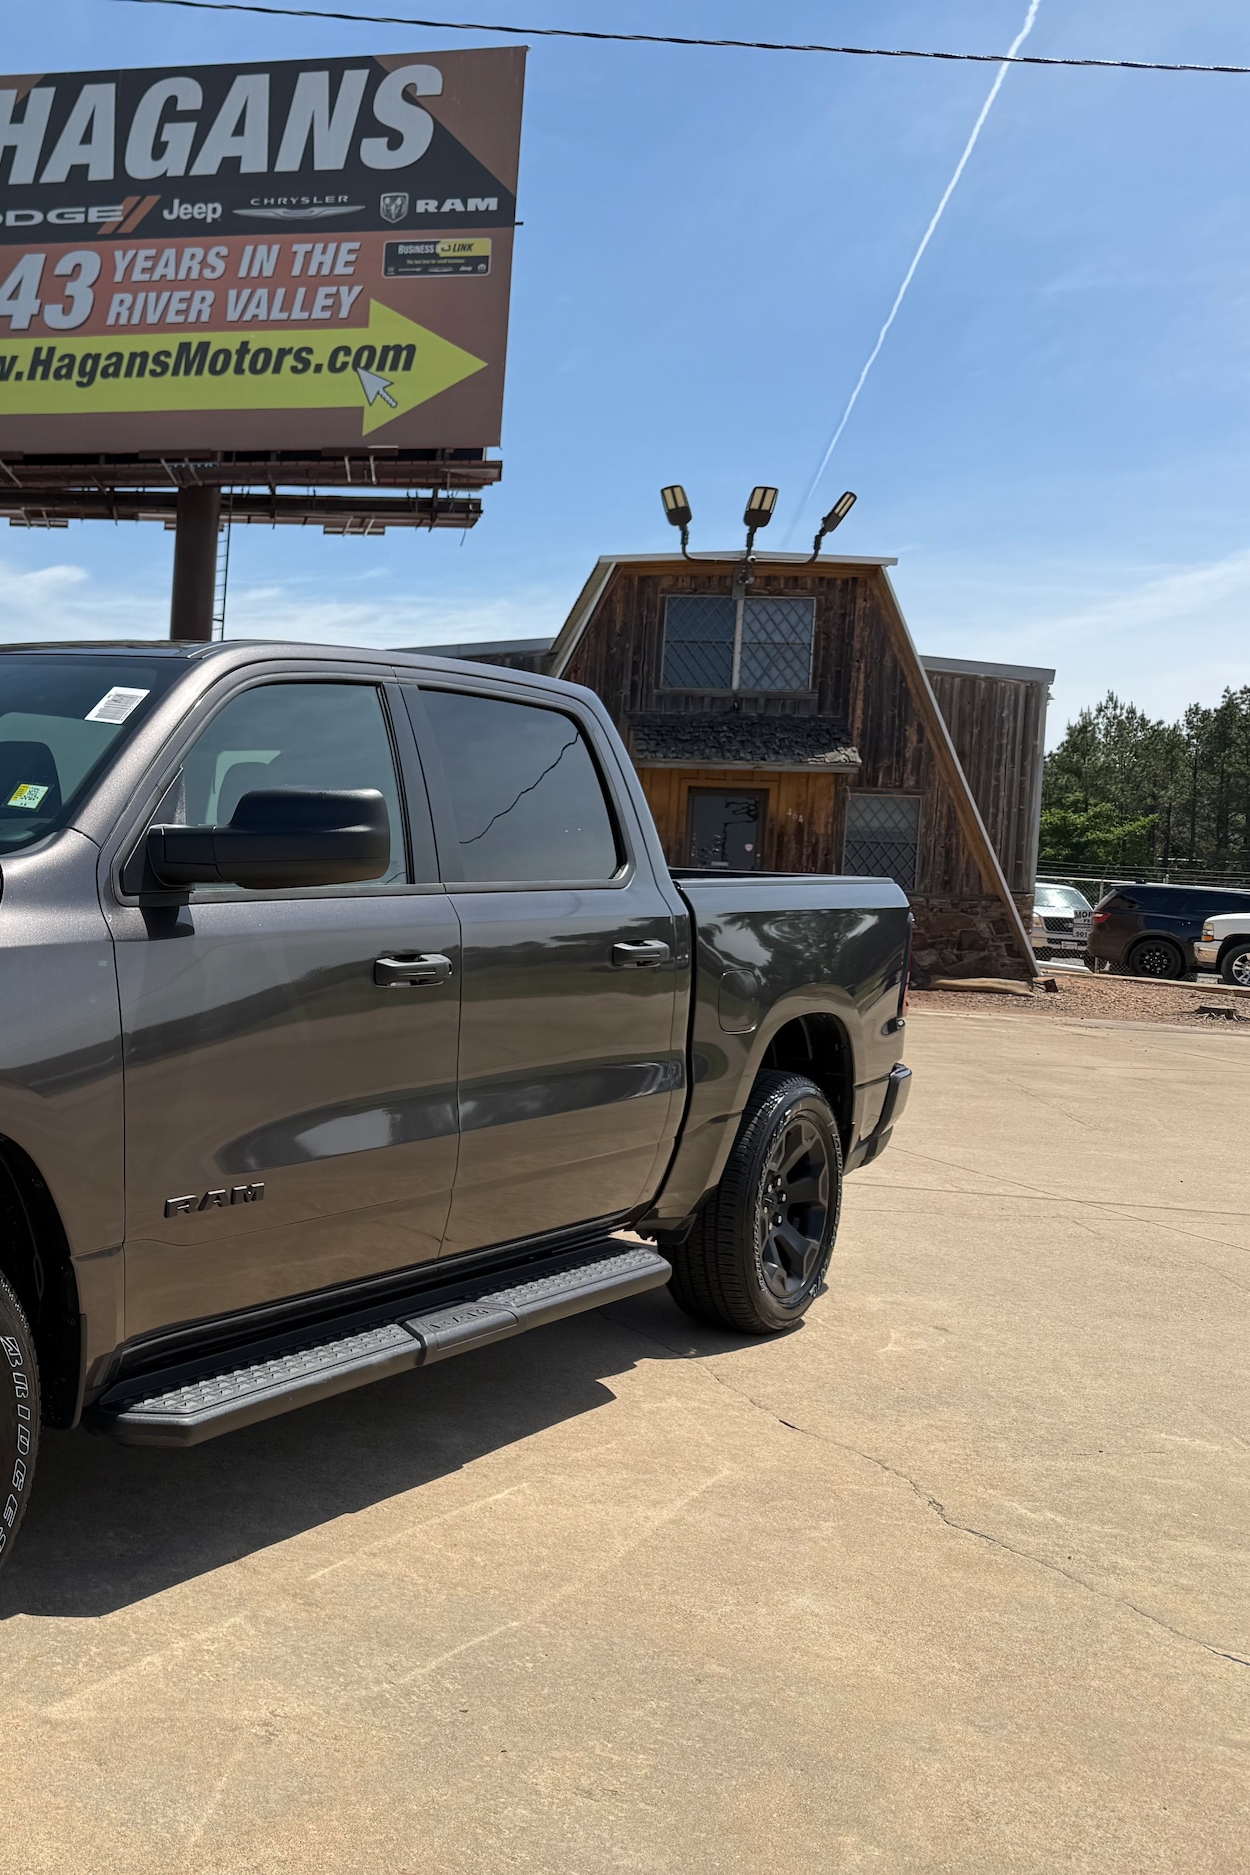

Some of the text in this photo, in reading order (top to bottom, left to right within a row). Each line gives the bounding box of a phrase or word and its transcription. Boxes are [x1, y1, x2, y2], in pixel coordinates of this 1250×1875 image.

[163, 199, 222, 223] Jeep
[250, 195, 349, 206] CHRYSLER
[415, 197, 499, 213] RAM
[398, 242, 474, 255] BUSINESS LINK
[113, 242, 361, 283] YEARS IN THE
[106, 285, 363, 326] RIVER VALLEY
[163, 1181, 265, 1219] RAM
